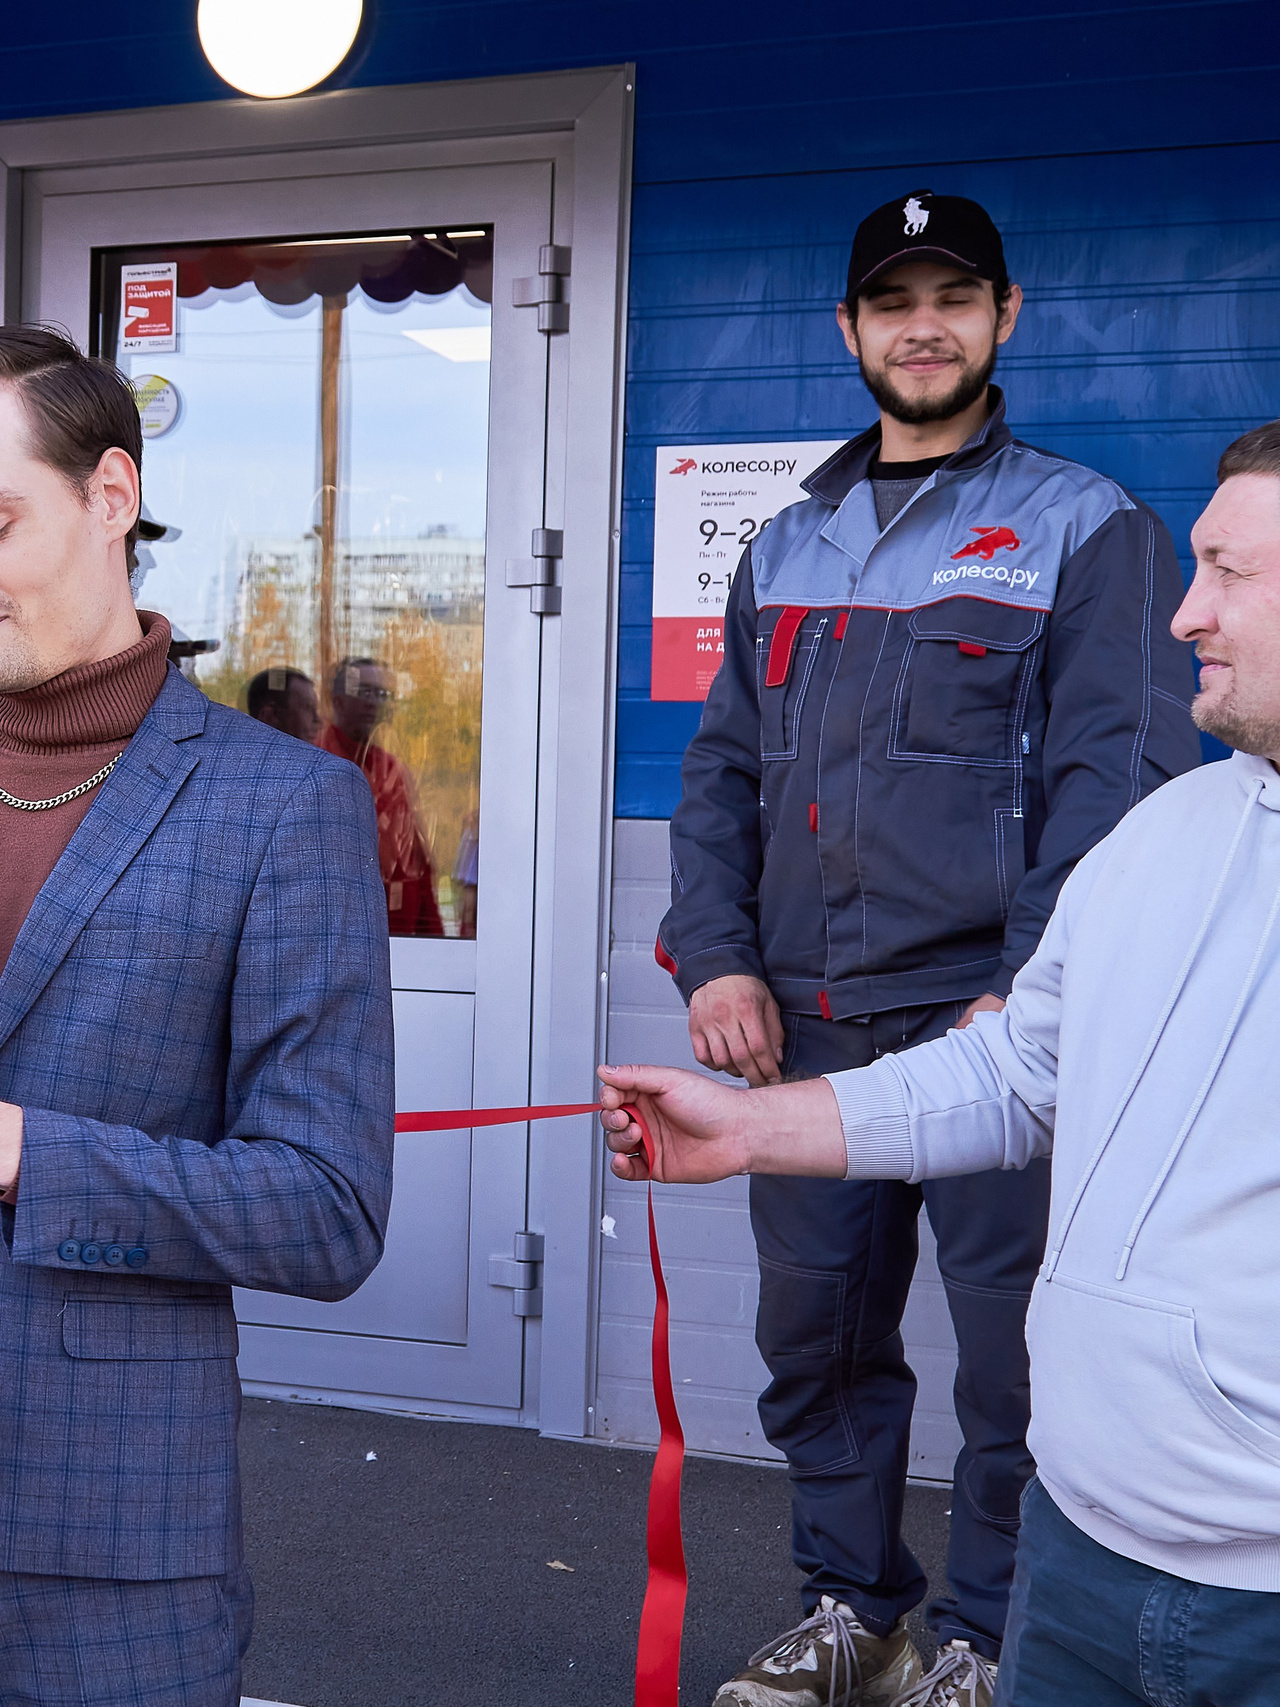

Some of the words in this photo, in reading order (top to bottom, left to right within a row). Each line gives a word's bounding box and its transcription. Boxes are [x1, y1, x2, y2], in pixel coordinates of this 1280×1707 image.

[128, 284, 147, 292] ПОД
[128, 289, 171, 299] ЗАЩИТОЙ
[701, 458, 797, 476] колесо.ру
[729, 489, 757, 498] работы
[698, 572, 732, 591] 9-1
[932, 565, 1040, 590] колесо.ру
[696, 628, 721, 639] ДЛЯ
[697, 642, 713, 652] НА
